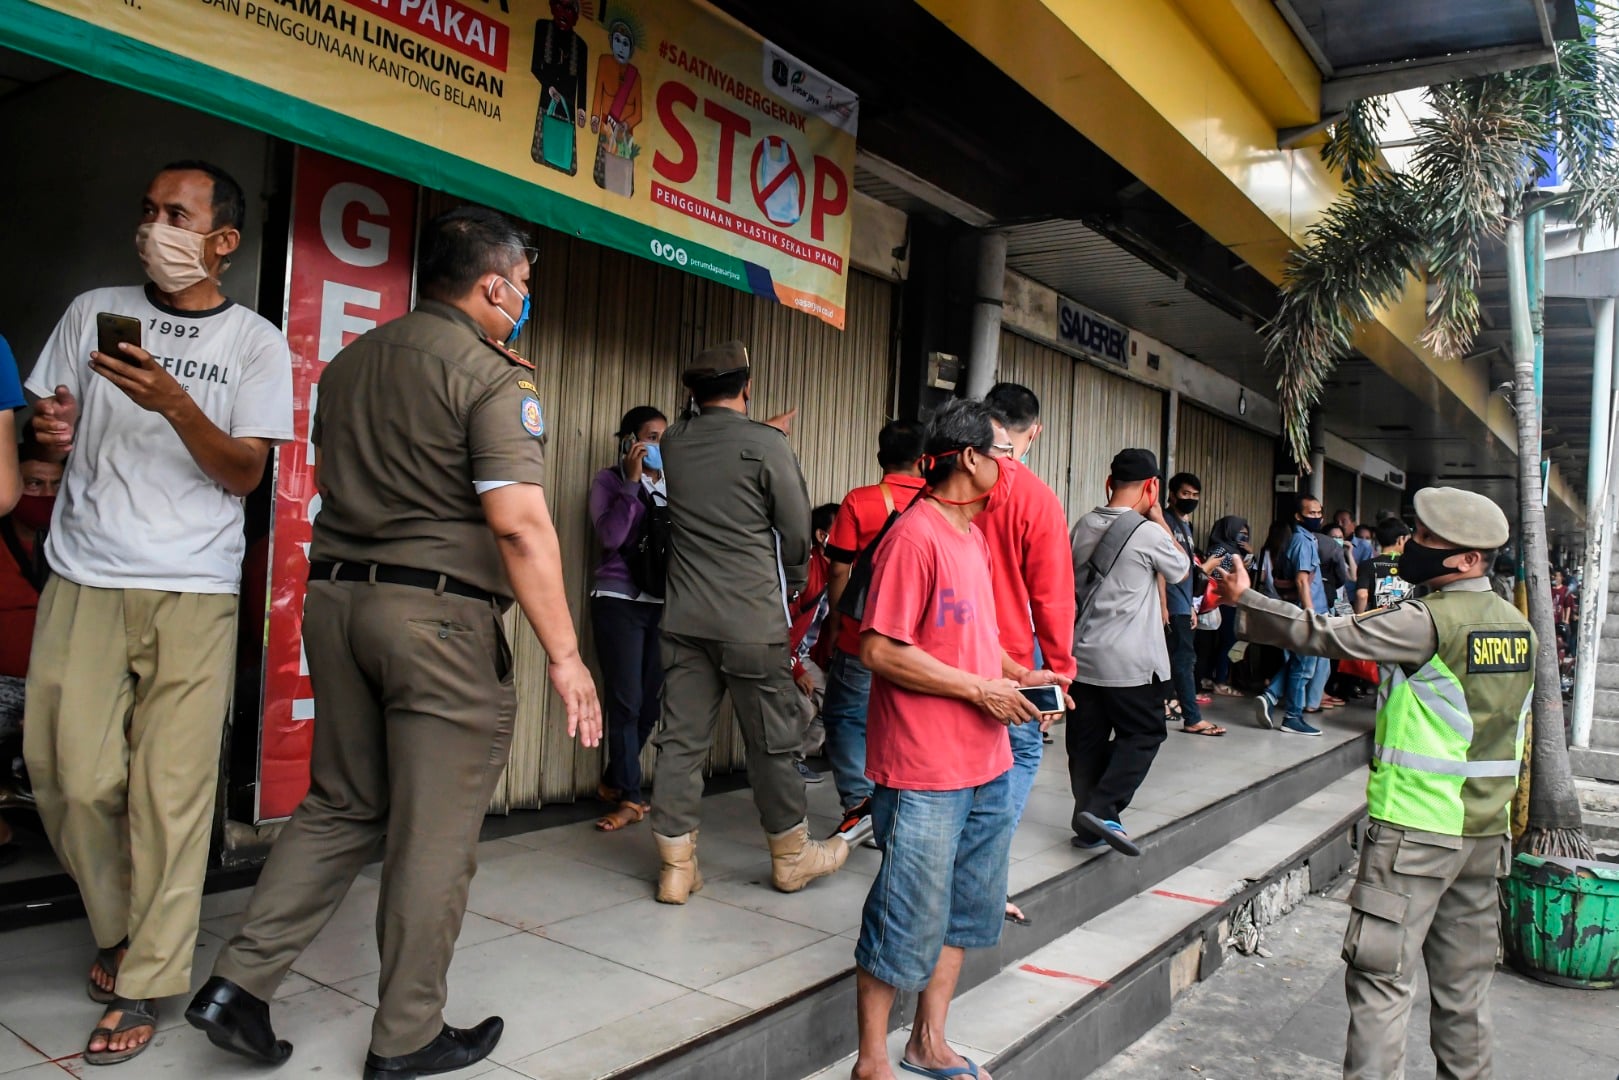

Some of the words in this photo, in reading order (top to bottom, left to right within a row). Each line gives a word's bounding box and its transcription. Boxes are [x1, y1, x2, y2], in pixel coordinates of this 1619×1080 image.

[245, 2, 365, 66] PENGGUNAAN
[368, 52, 441, 97] KANTONG
[443, 83, 502, 122] BELANJA
[362, 20, 504, 98] LINGKUNGAN
[399, 0, 497, 57] PAKAI
[659, 40, 808, 134] #SAATNYABERGERAK
[653, 80, 849, 242] STOP
[656, 187, 733, 229] PENGGUNAAN
[735, 220, 778, 245] PLASTIK
[780, 237, 812, 260] SEKALI
[815, 250, 840, 270] PAKAI
[149, 317, 200, 339] 1992
[1059, 305, 1128, 364] SADEREK
[152, 355, 229, 385] FICIAL
[1473, 637, 1515, 665] SATPOL
[1515, 637, 1529, 664] PP
